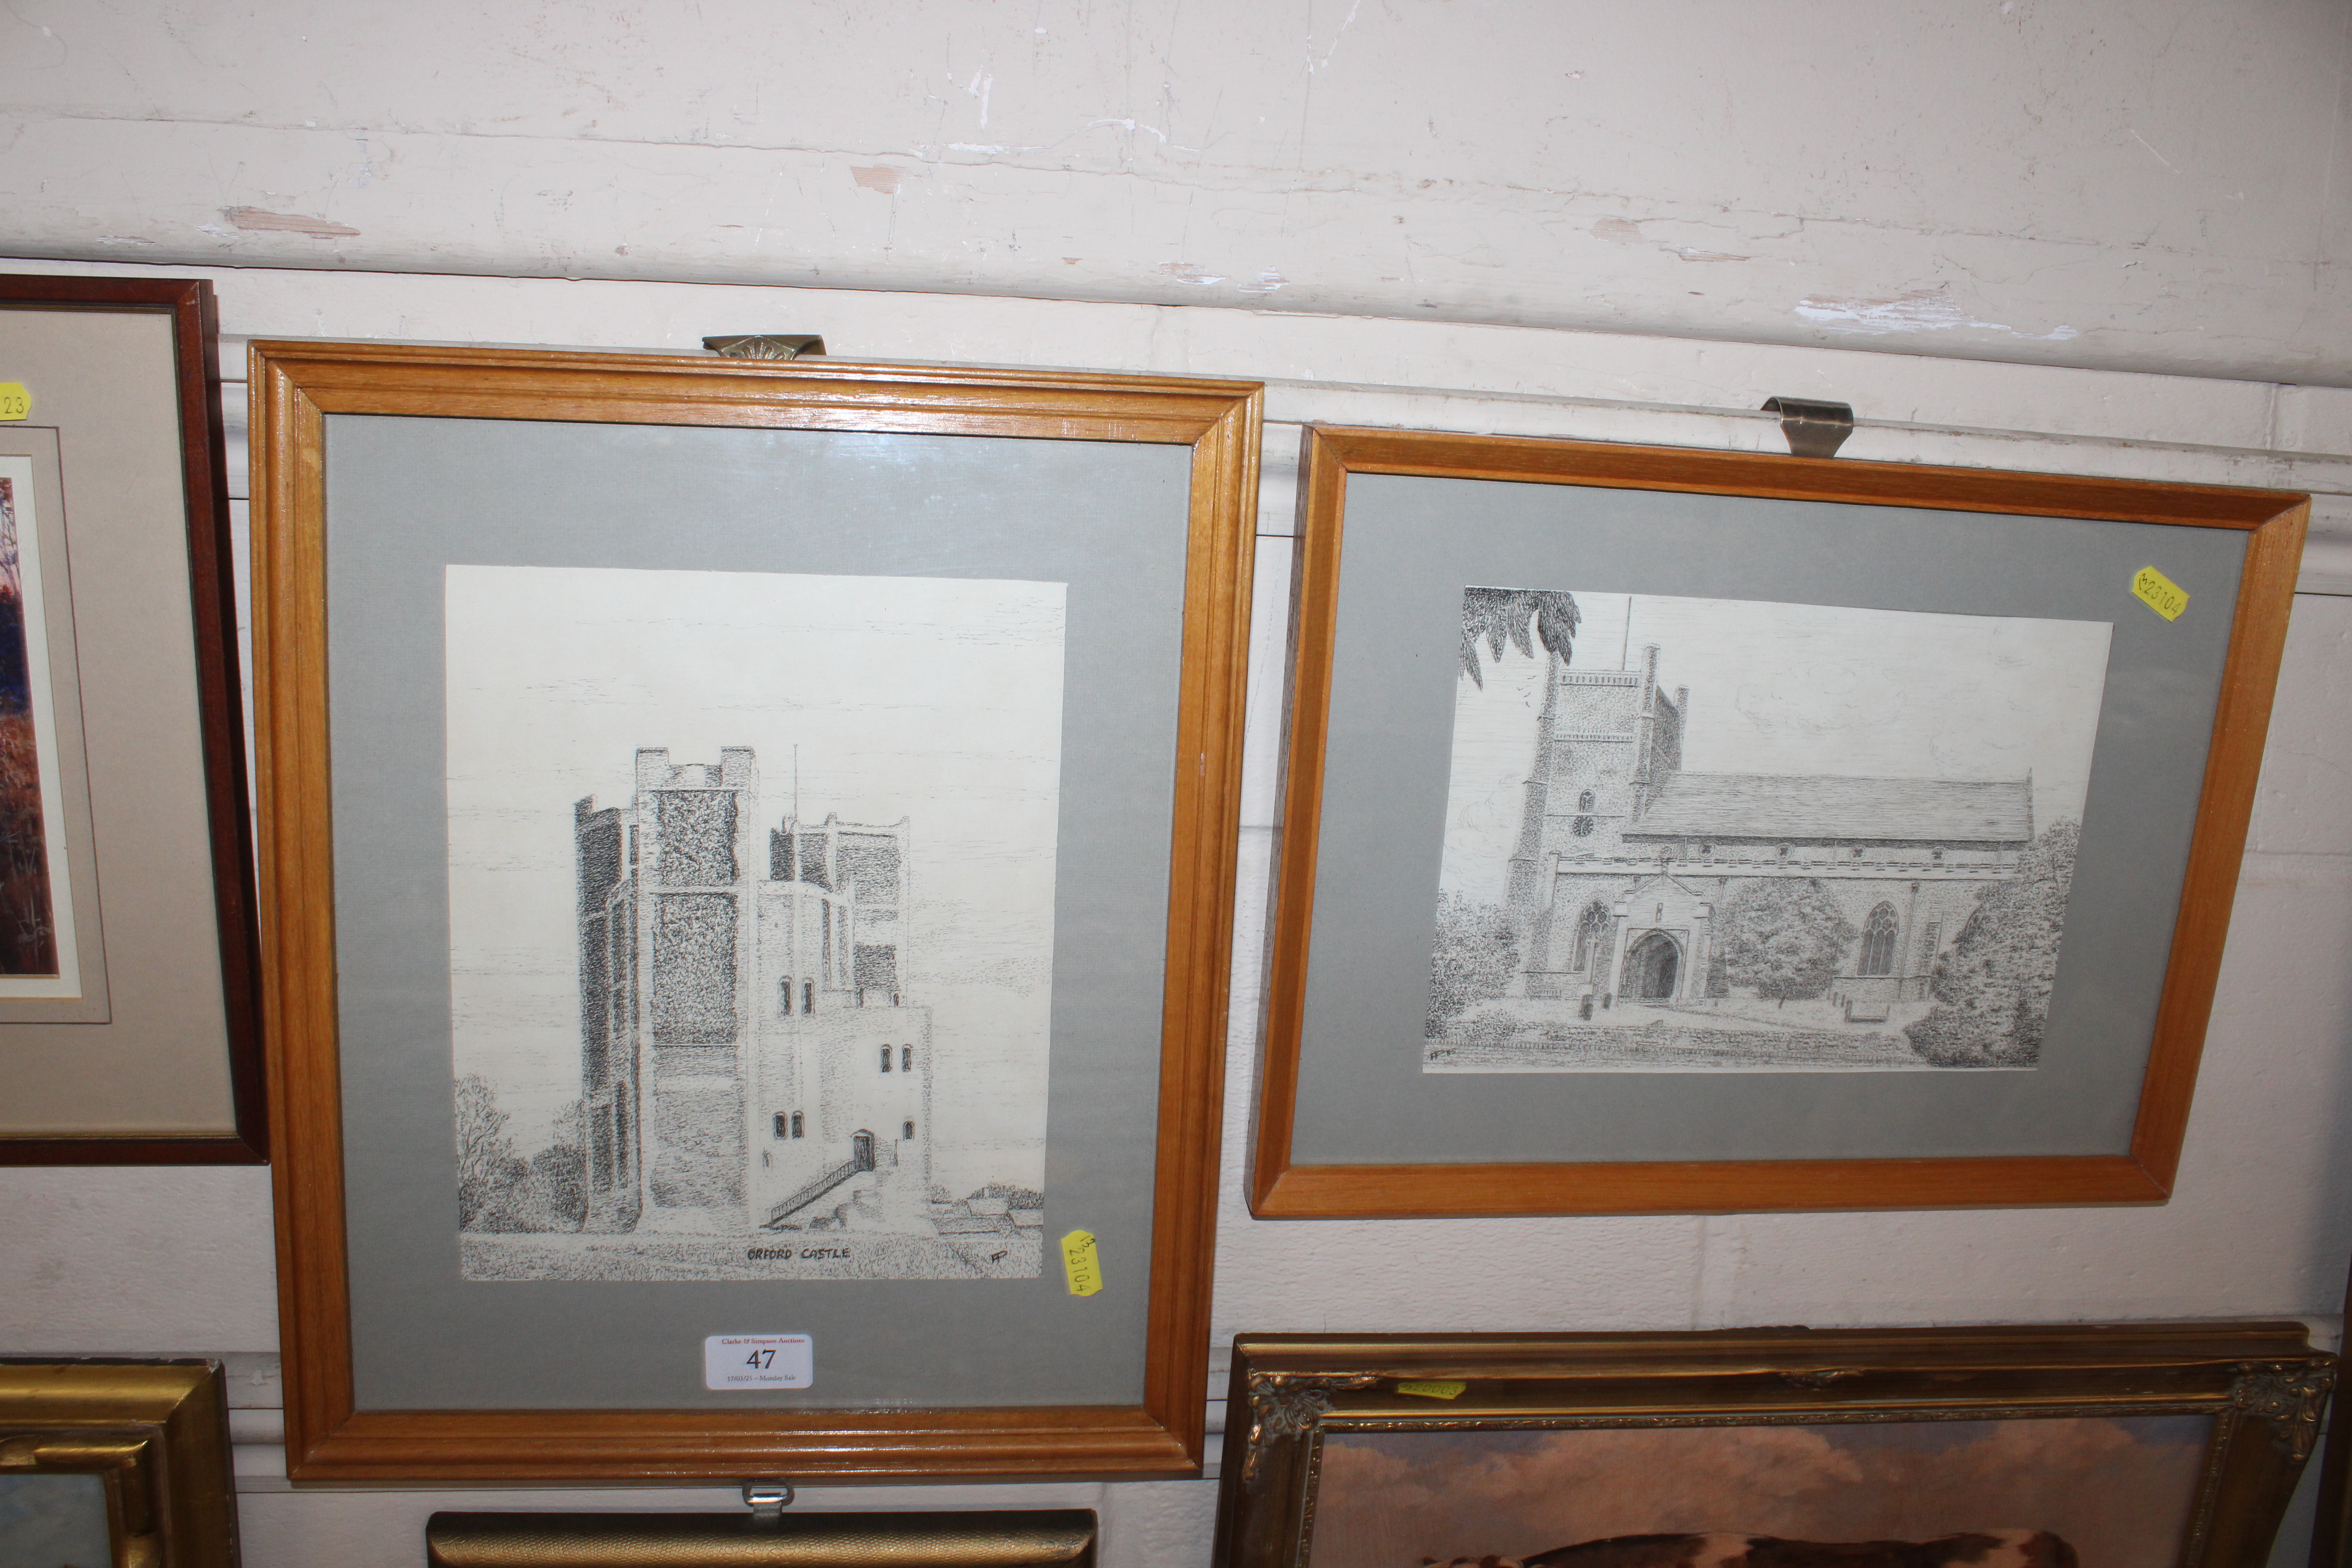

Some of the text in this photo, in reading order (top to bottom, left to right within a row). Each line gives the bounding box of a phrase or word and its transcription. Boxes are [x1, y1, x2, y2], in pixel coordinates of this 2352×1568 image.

[2144, 581, 2181, 615] 23104
[748, 1247, 851, 1260] ORFORD CASTLE
[1069, 1247, 1090, 1292] 23104
[746, 1348, 777, 1369] 47
